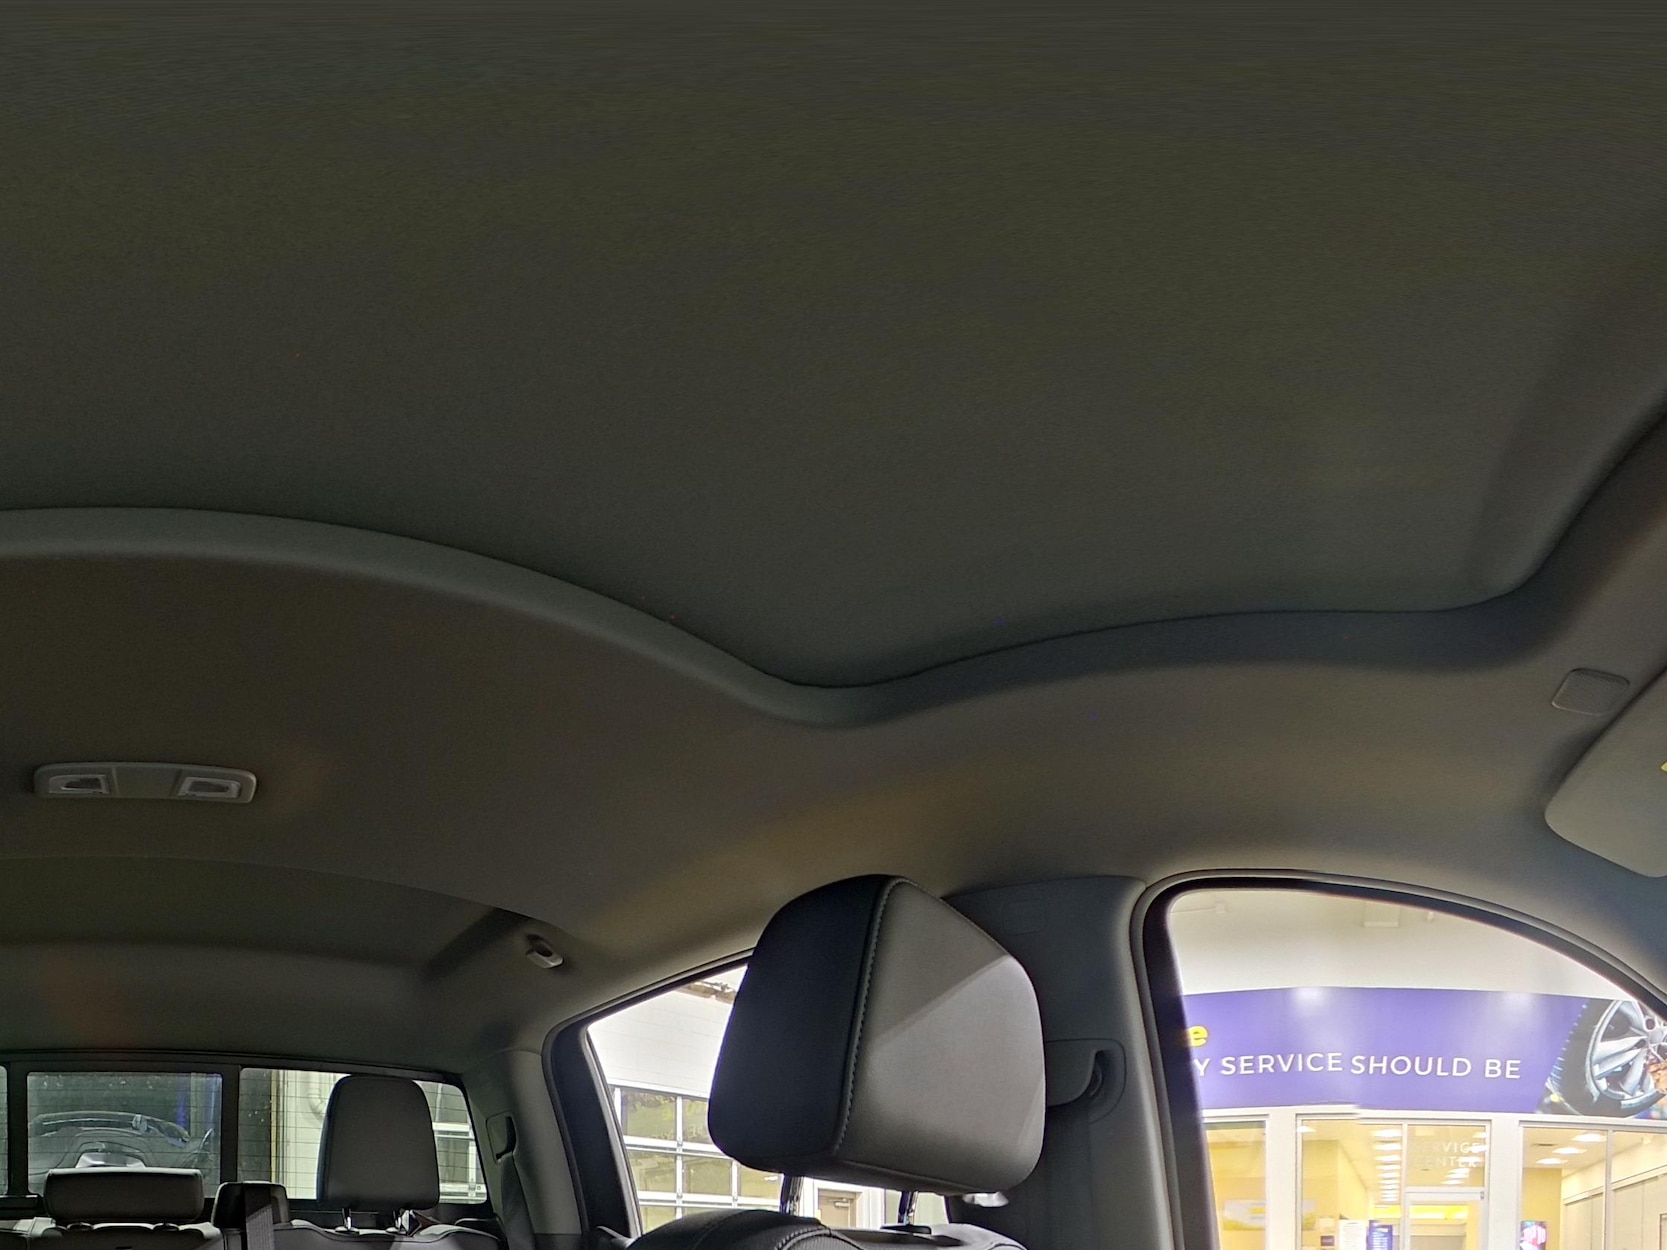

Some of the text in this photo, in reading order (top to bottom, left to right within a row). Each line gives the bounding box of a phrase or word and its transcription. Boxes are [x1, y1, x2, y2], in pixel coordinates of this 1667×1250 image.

[1220, 1052, 1343, 1076] SERVICE
[1350, 1055, 1472, 1077] SHOULD
[1484, 1058, 1522, 1079] BE
